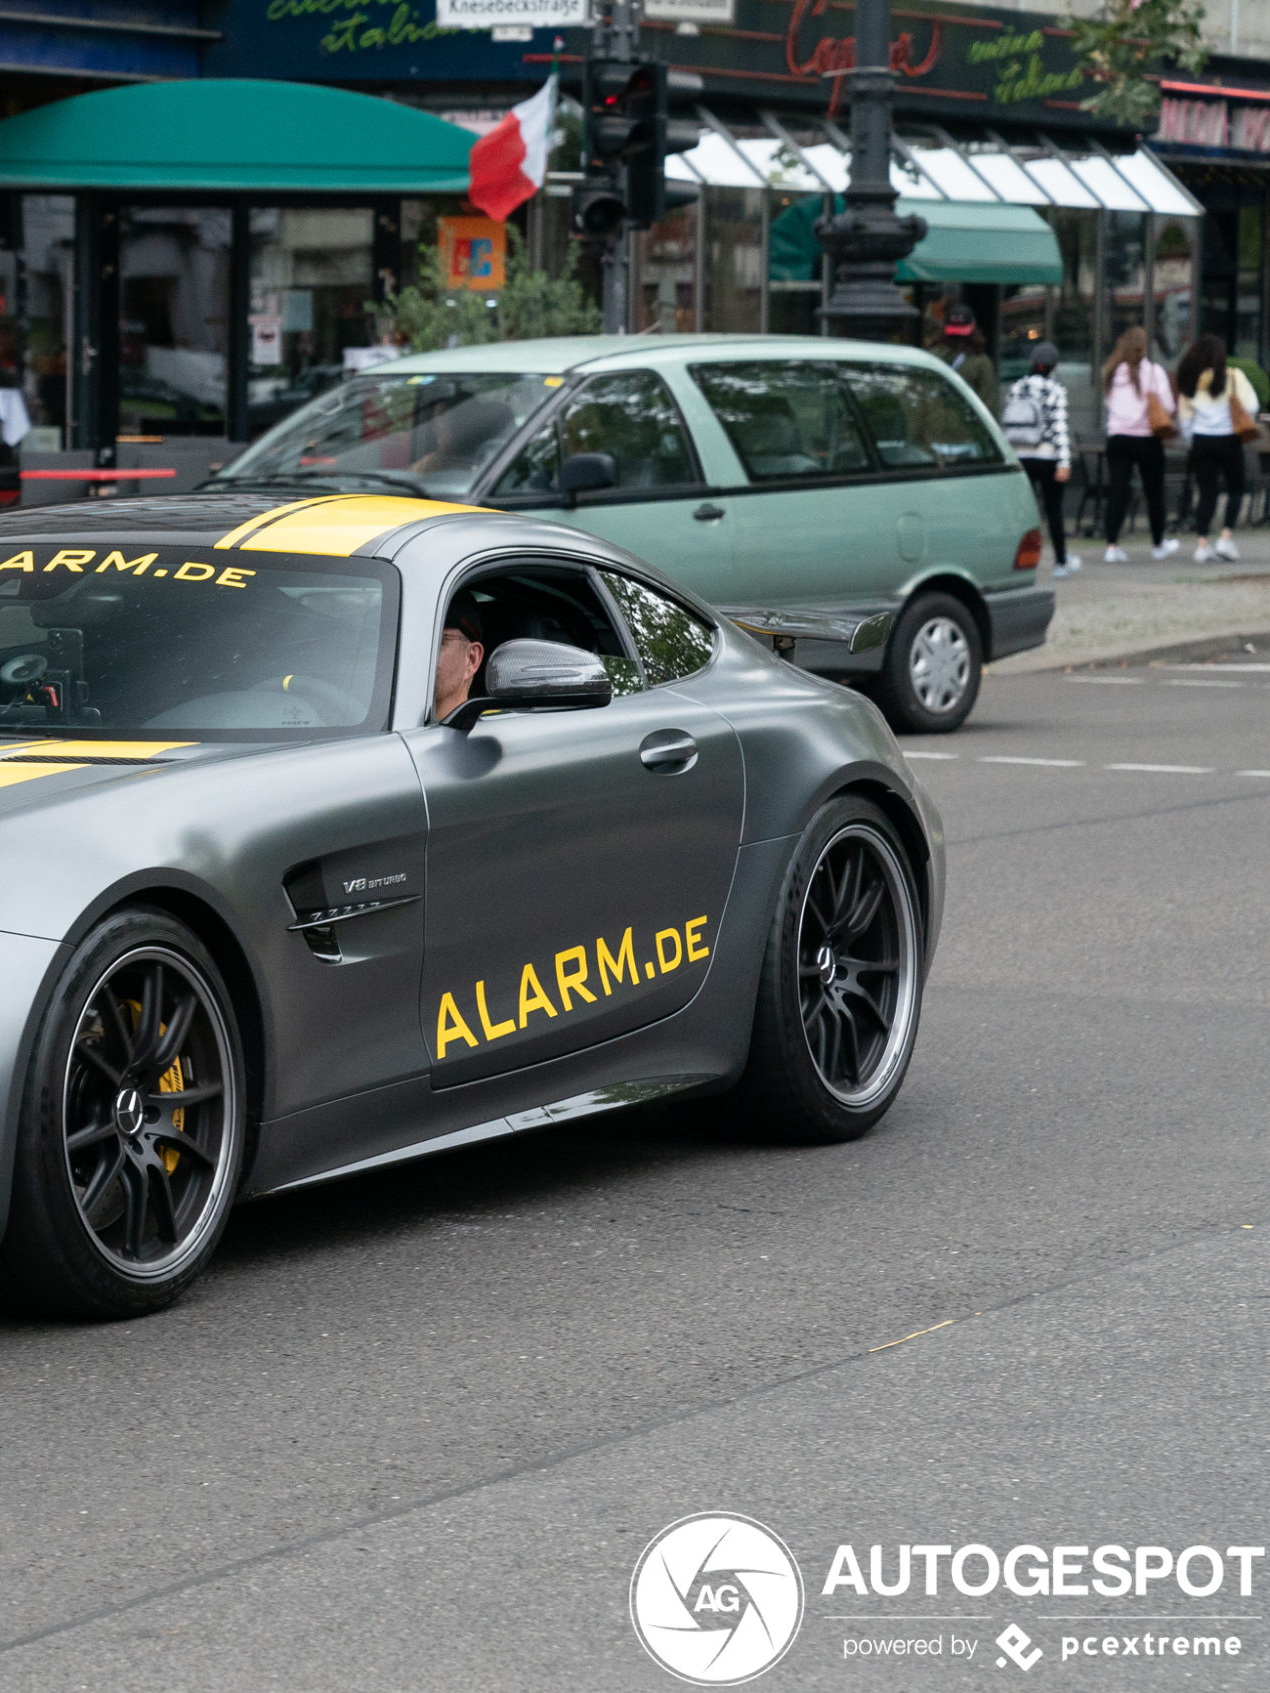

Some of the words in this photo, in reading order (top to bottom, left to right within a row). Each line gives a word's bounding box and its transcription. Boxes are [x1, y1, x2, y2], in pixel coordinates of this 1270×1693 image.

[343, 878, 367, 894] V8
[368, 873, 407, 889] BITURBO
[437, 915, 710, 1060] ALARM.DE
